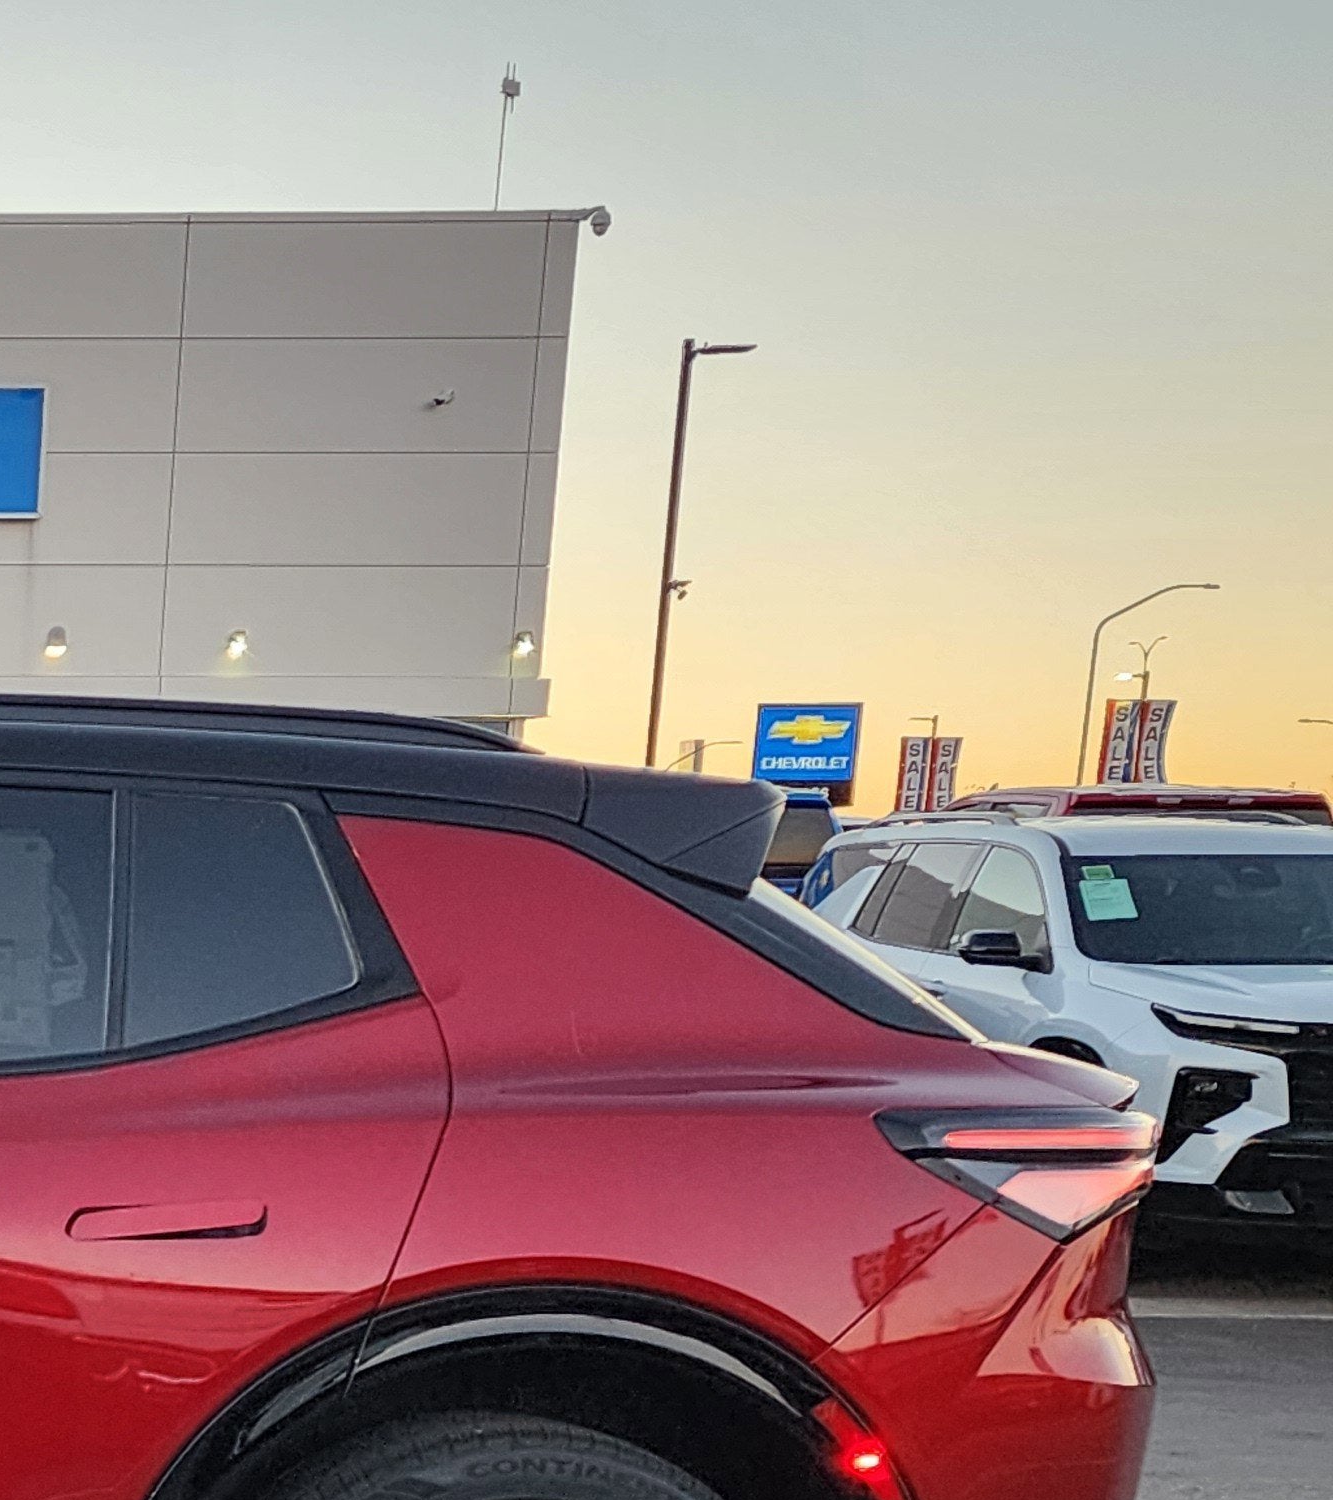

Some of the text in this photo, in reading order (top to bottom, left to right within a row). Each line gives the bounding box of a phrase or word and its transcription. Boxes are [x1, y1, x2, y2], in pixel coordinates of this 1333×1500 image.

[759, 756, 850, 770] CHEVROLET
[937, 743, 953, 808] SALE
[1108, 705, 1130, 780] SALE
[1143, 707, 1164, 780] SALE
[904, 743, 921, 809] SALE
